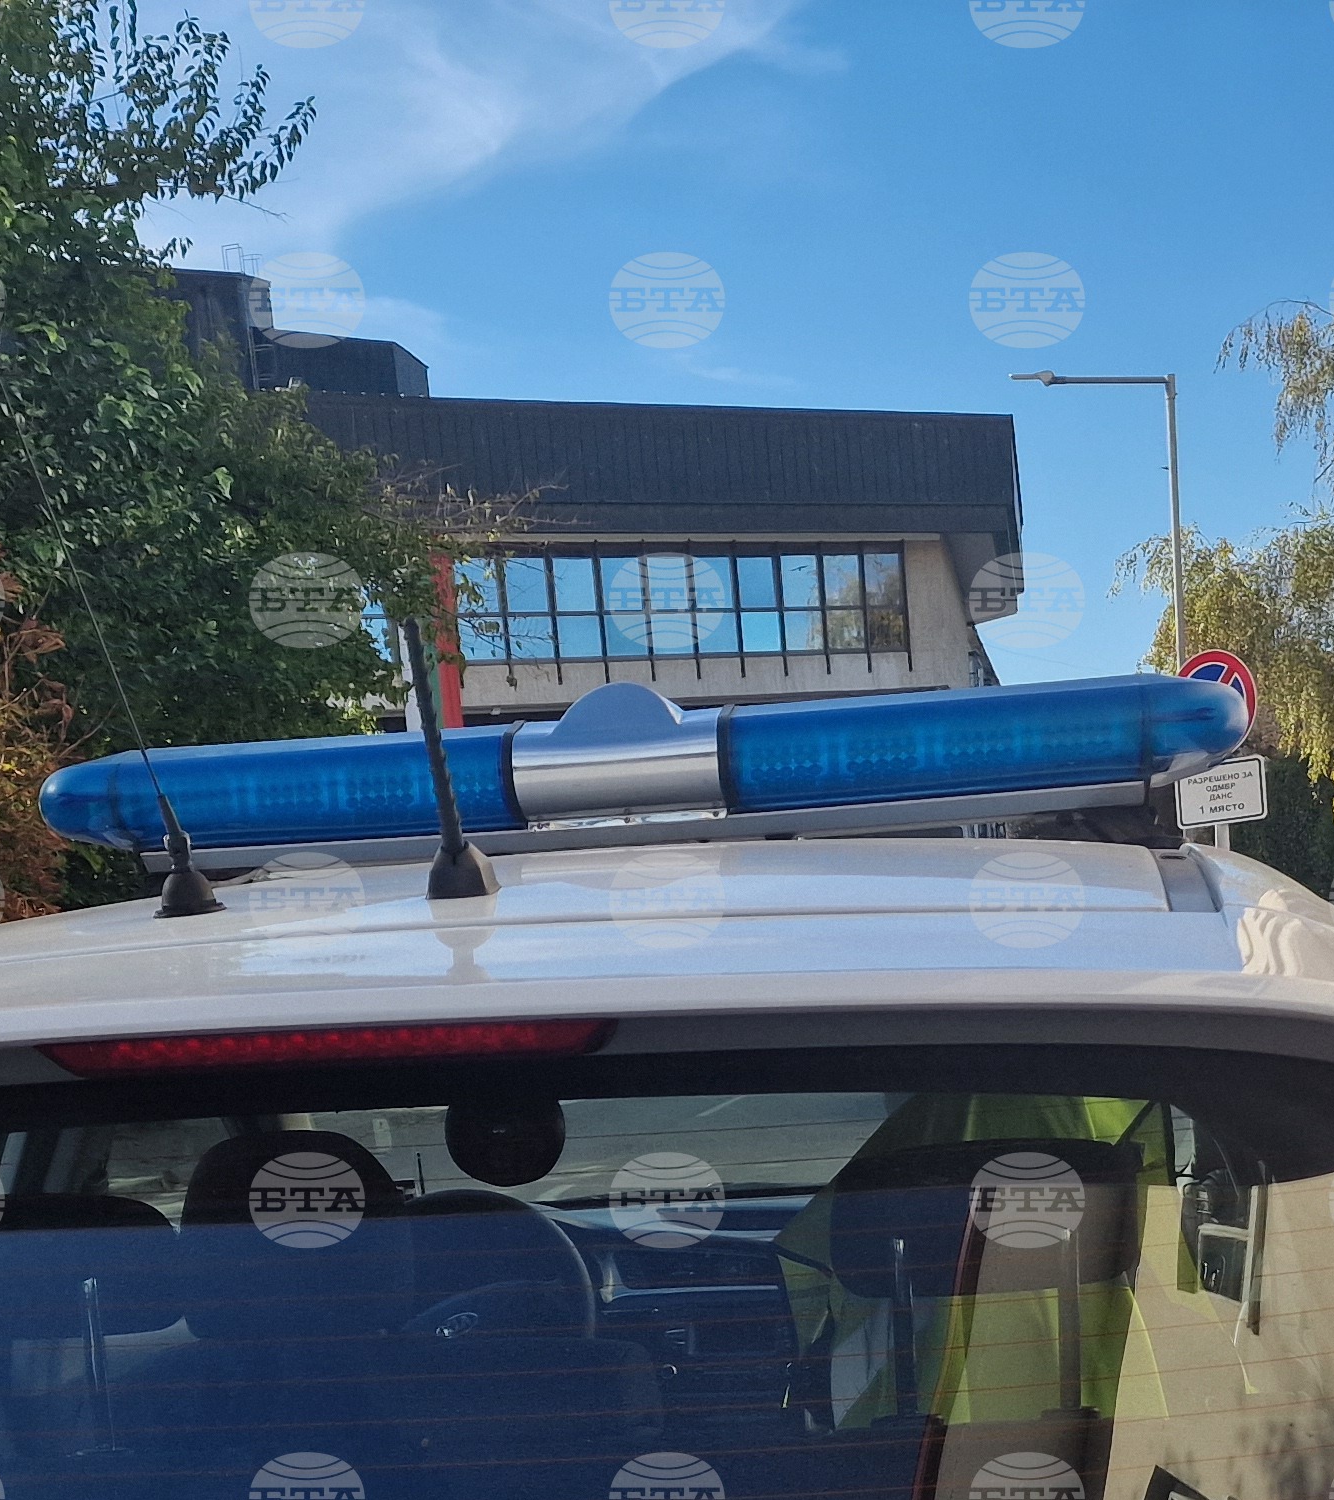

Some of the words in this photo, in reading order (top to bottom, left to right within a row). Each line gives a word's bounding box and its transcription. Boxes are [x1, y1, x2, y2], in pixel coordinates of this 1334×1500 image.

[1187, 772, 1240, 786] РАЗРЕШЕНО
[1242, 771, 1254, 779] ЗА
[1209, 792, 1233, 802] ДАНС
[1199, 806, 1205, 814] 1
[1209, 803, 1245, 814] МЯСТО
